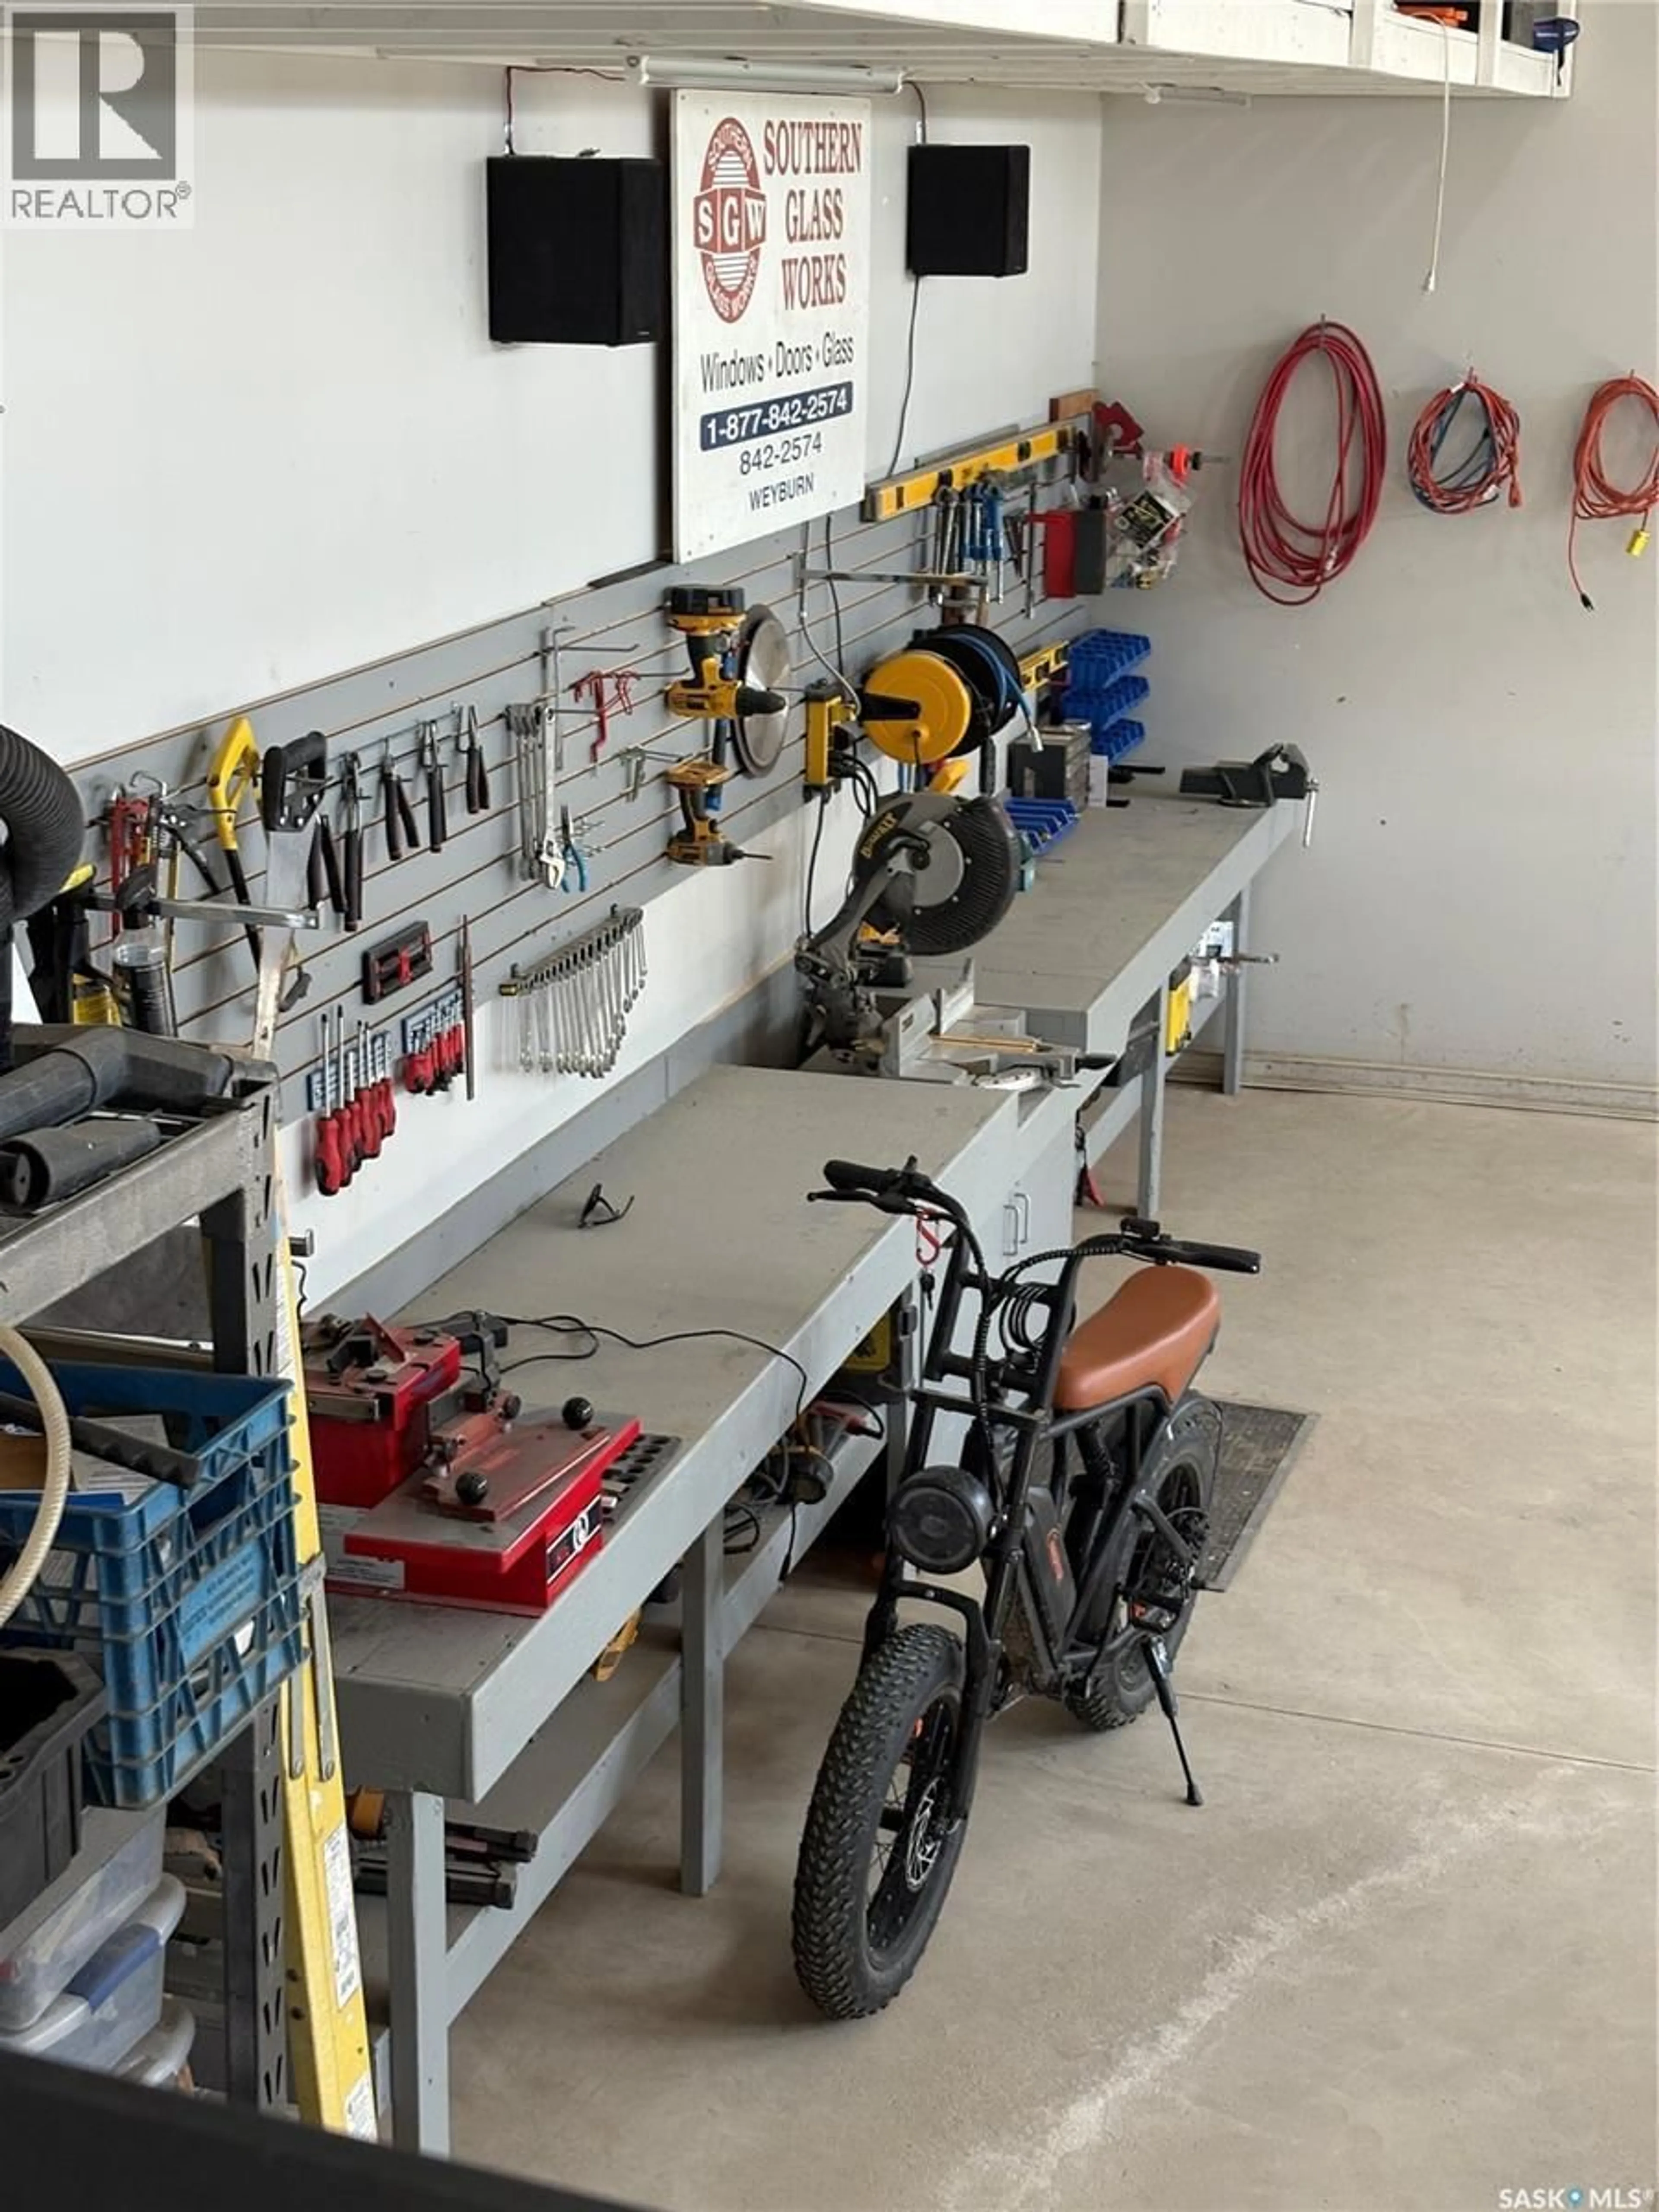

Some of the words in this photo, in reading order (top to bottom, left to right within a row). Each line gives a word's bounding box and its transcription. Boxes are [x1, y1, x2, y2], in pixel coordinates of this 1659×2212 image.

[763, 119, 862, 176] SOUTHERN
[697, 196, 766, 246] SGW
[785, 188, 844, 244] GLASS
[782, 253, 846, 311] WORKS
[700, 350, 765, 393] Windows
[776, 341, 812, 379] Doors
[822, 331, 855, 368] Glass
[707, 388, 848, 444] 1-877-842-2574
[739, 431, 823, 475] 842-2574
[749, 472, 814, 511] WEYBURN
